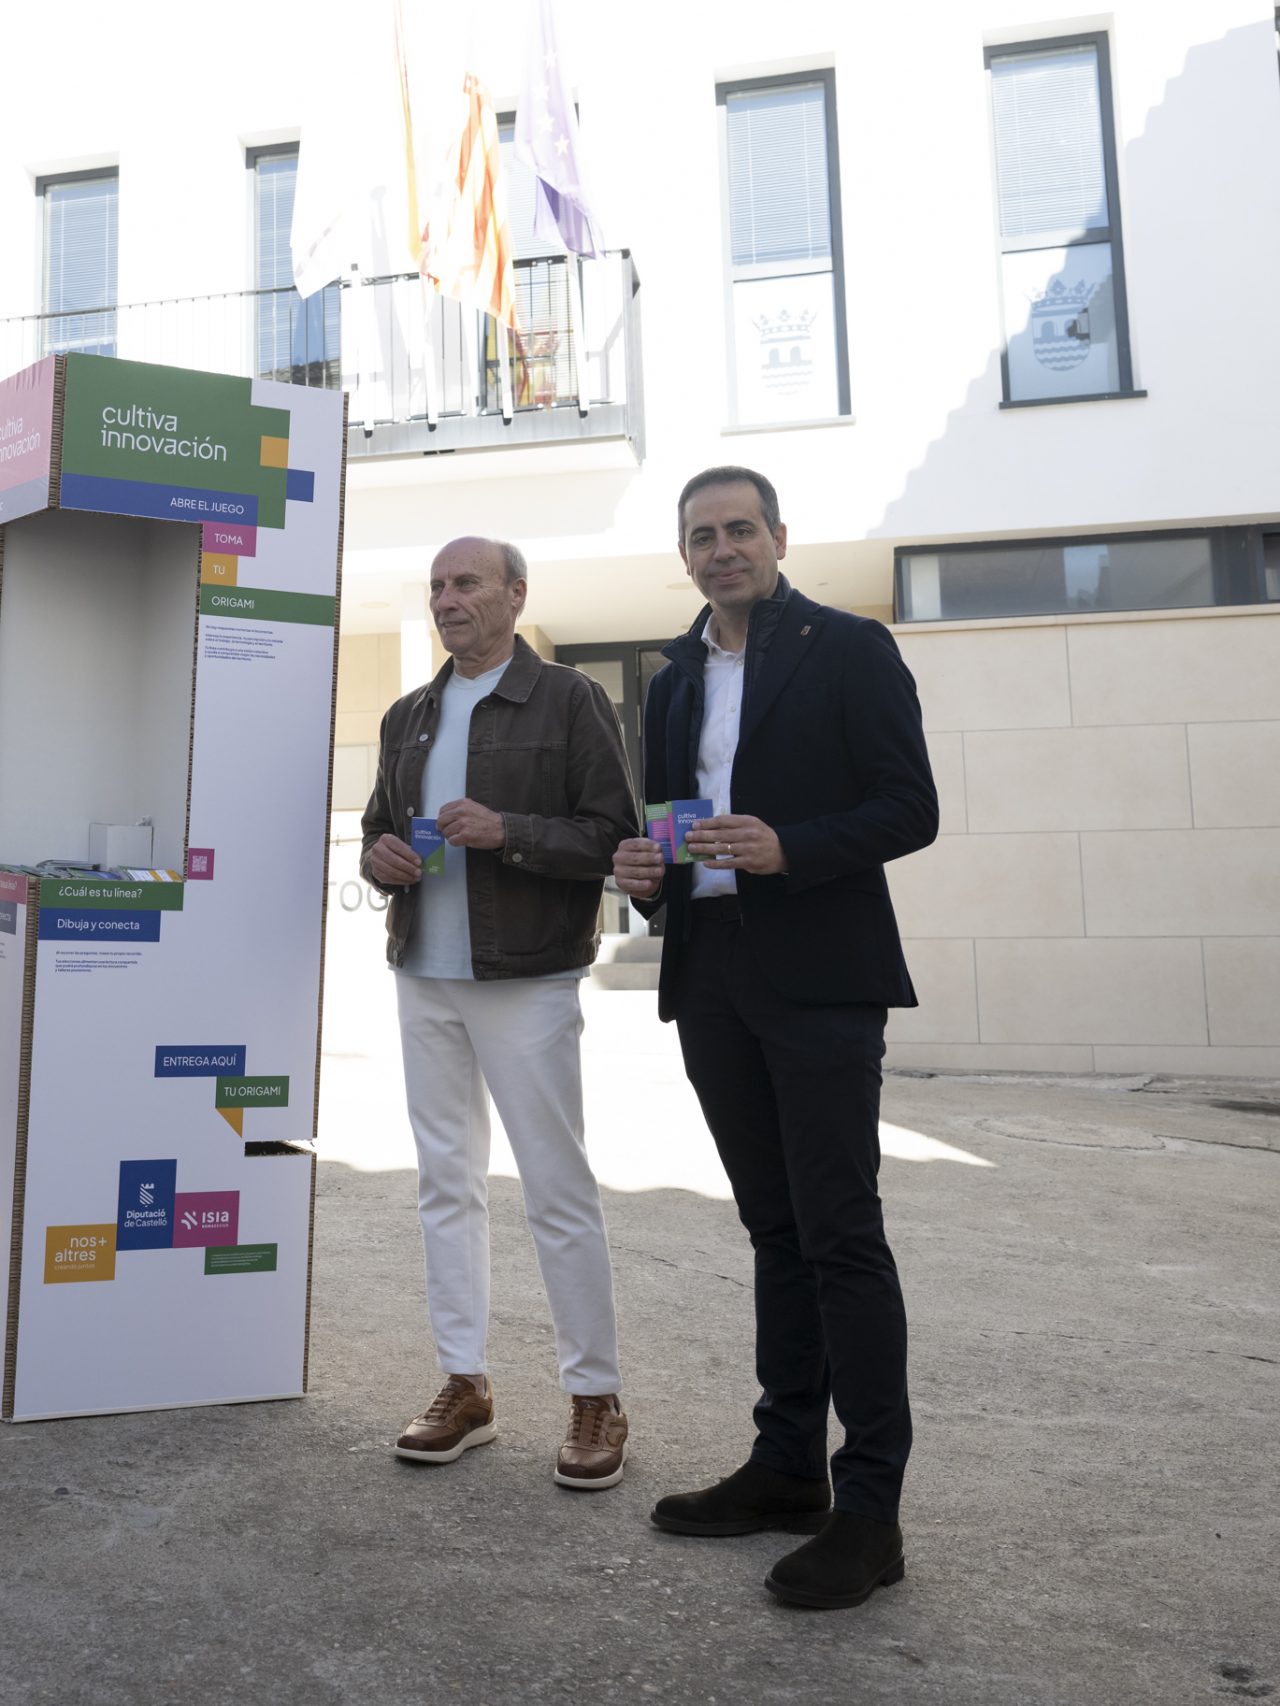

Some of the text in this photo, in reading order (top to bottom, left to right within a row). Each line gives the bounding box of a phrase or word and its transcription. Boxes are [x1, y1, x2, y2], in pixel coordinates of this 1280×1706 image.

[101, 404, 178, 432] cultiva
[100, 424, 227, 462] innovación
[170, 497, 244, 515] ABRE EL JUEGO
[214, 533, 243, 545] TOMA
[213, 564, 225, 575] TU
[211, 595, 255, 609] ORIGAMI
[58, 885, 143, 899] ¿Cuál es tu línea?
[57, 918, 141, 932] Dibuja y conecta
[163, 1053, 237, 1067] ENTREGA AQUÍ
[224, 1086, 281, 1097] TU ORIGAMI
[126, 1208, 166, 1220] Diputació
[124, 1217, 168, 1228] de Castelló
[54, 1248, 96, 1263] altres
